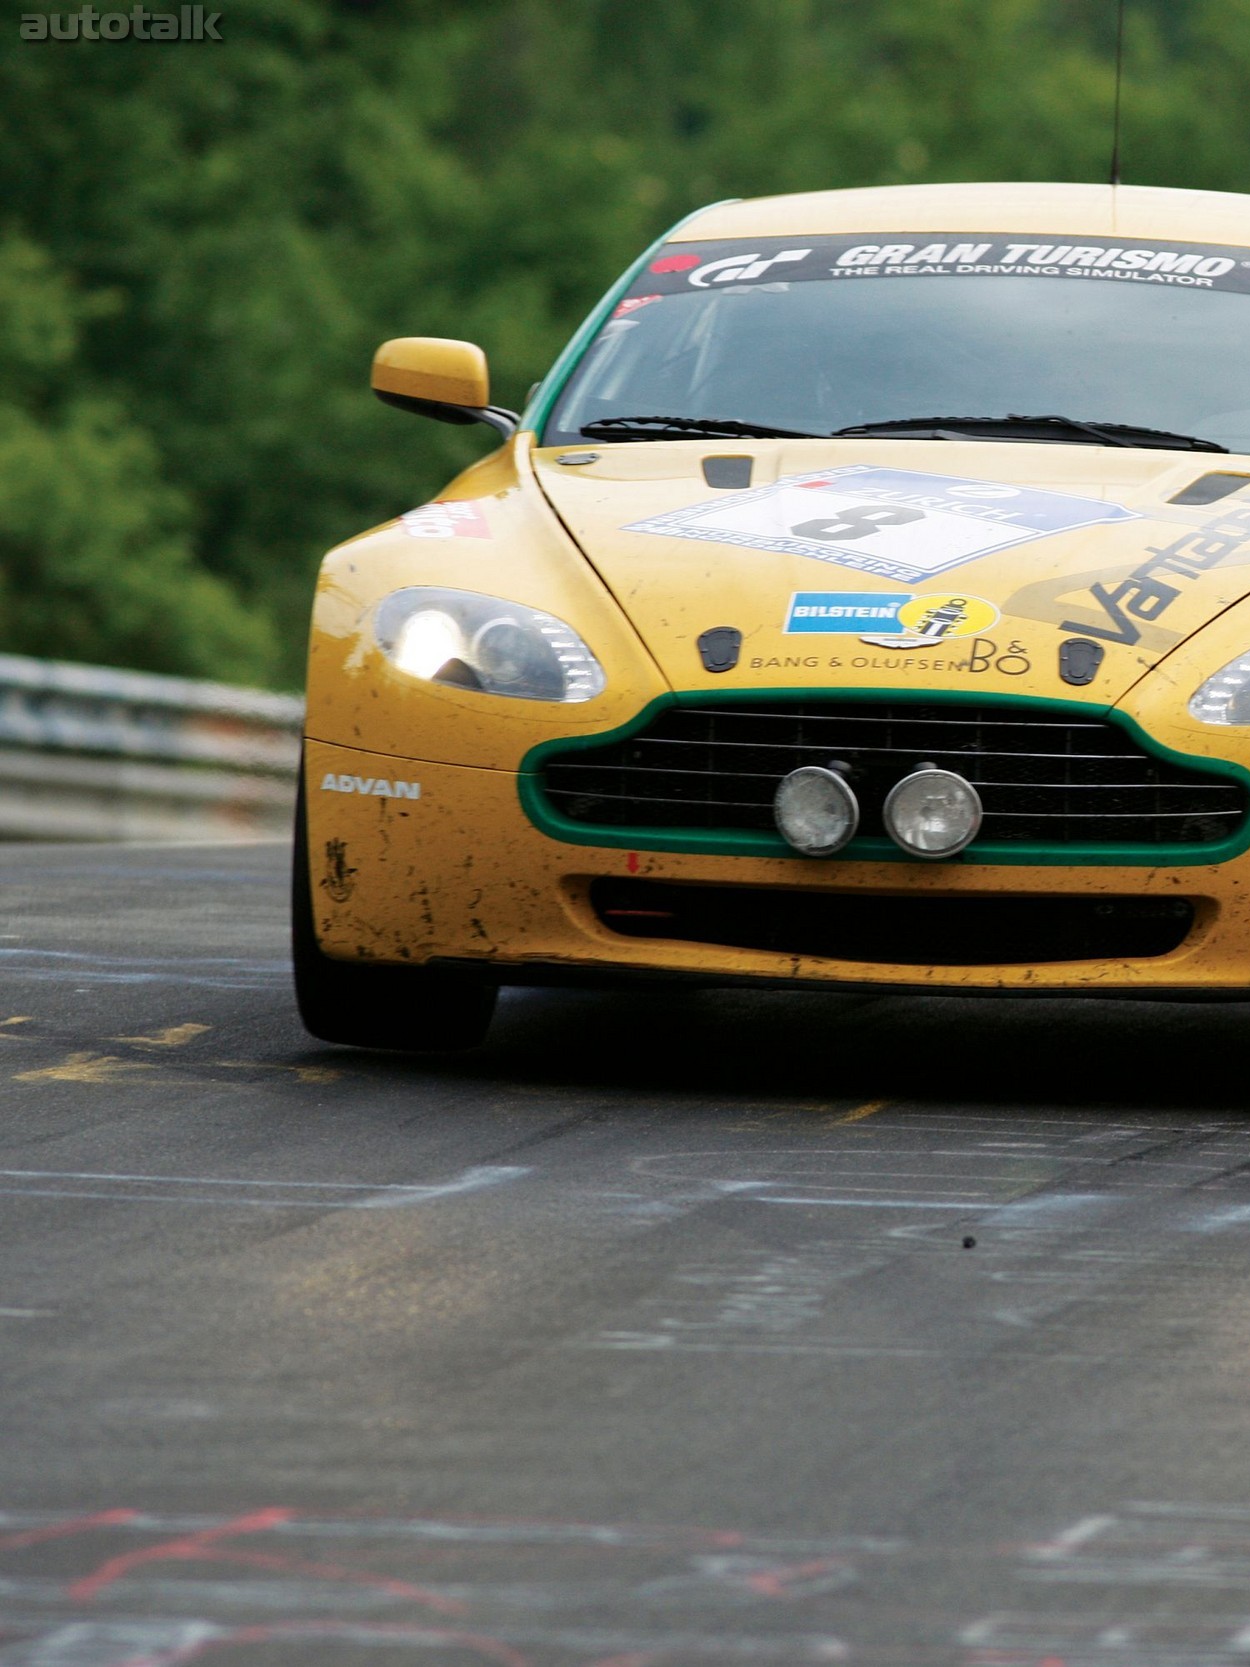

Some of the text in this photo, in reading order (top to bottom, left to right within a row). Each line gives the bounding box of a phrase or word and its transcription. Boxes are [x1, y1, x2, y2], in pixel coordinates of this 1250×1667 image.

[836, 243, 1236, 277] GRAN TURISMO
[829, 265, 1214, 287] THE REAL DRIVING SIMULATOR
[853, 487, 1025, 521] ZURICH
[790, 505, 927, 541] 8
[793, 605, 897, 619] BILSTEIN
[749, 656, 963, 671] BANG & OLUFSEN
[320, 774, 421, 800] ADVAN
